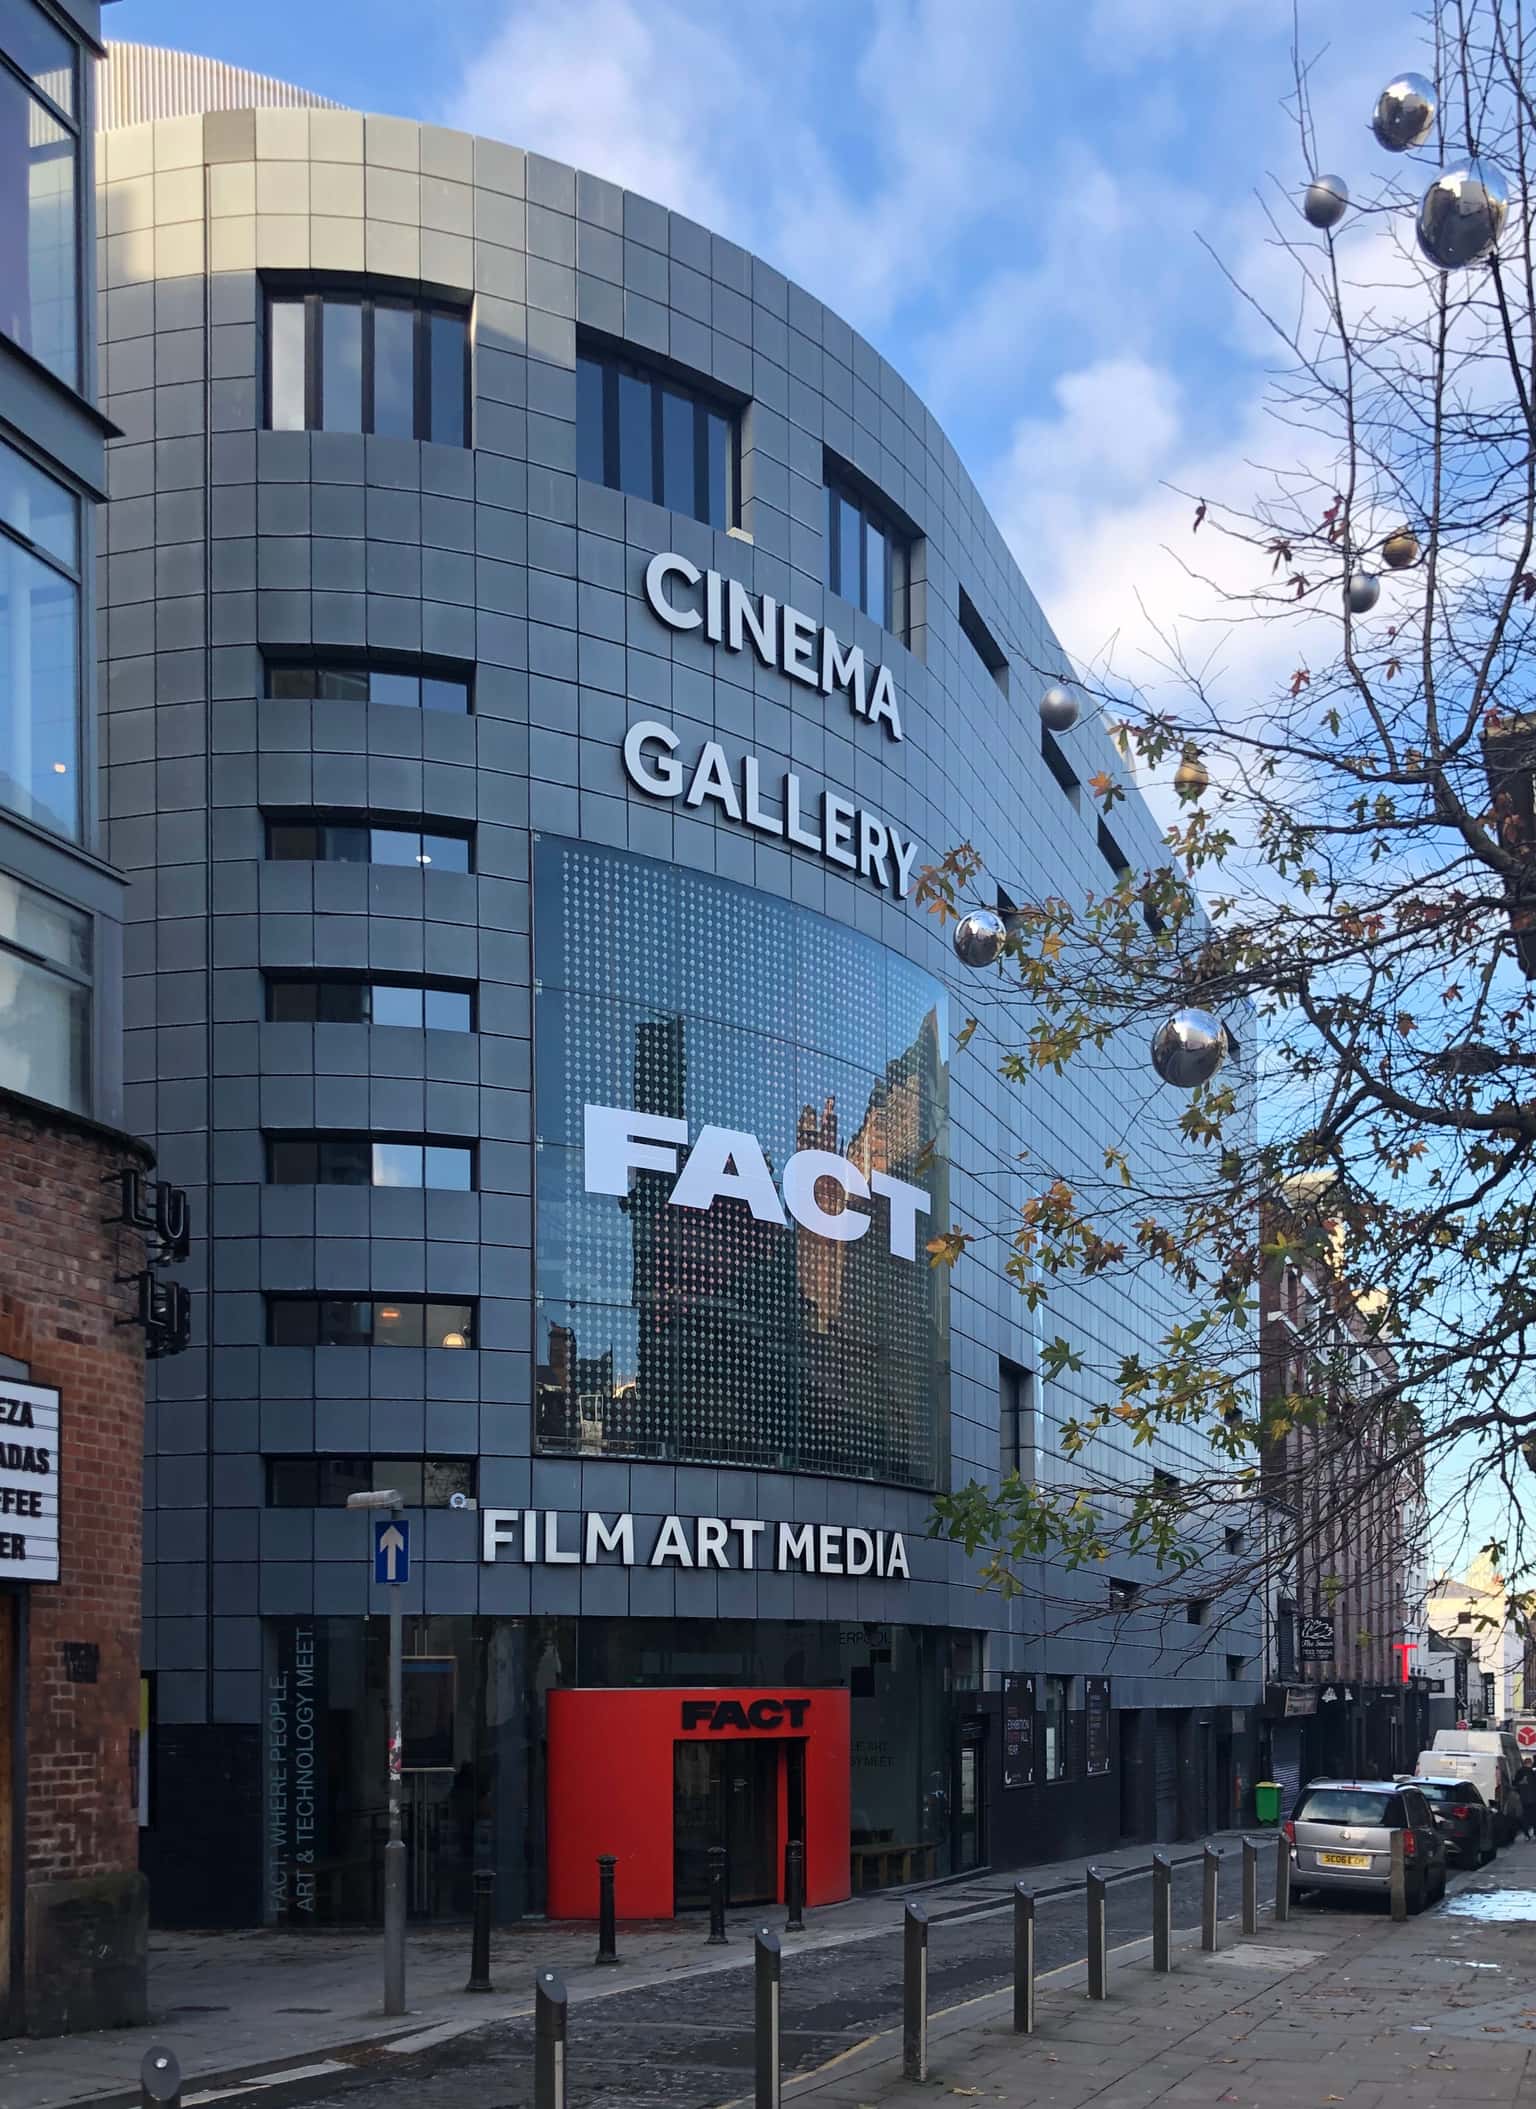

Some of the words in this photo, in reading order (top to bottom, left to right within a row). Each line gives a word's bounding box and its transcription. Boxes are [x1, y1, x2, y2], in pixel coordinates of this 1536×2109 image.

[645, 552, 903, 742] CINEMA
[623, 720, 919, 900] GALLERY
[584, 1103, 931, 1262] FACT
[0, 1487, 42, 1518] FEE
[483, 1509, 636, 1565] FILM
[650, 1516, 765, 1570] ART
[778, 1522, 911, 1579] MEDIA
[270, 1670, 289, 1761] PEOPLE,
[680, 1699, 811, 1731] FACT
[270, 1767, 288, 1848] WHERE
[296, 1692, 315, 1845] TECHNOLOGY
[296, 1848, 315, 1864] &
[296, 1870, 315, 1912] ART
